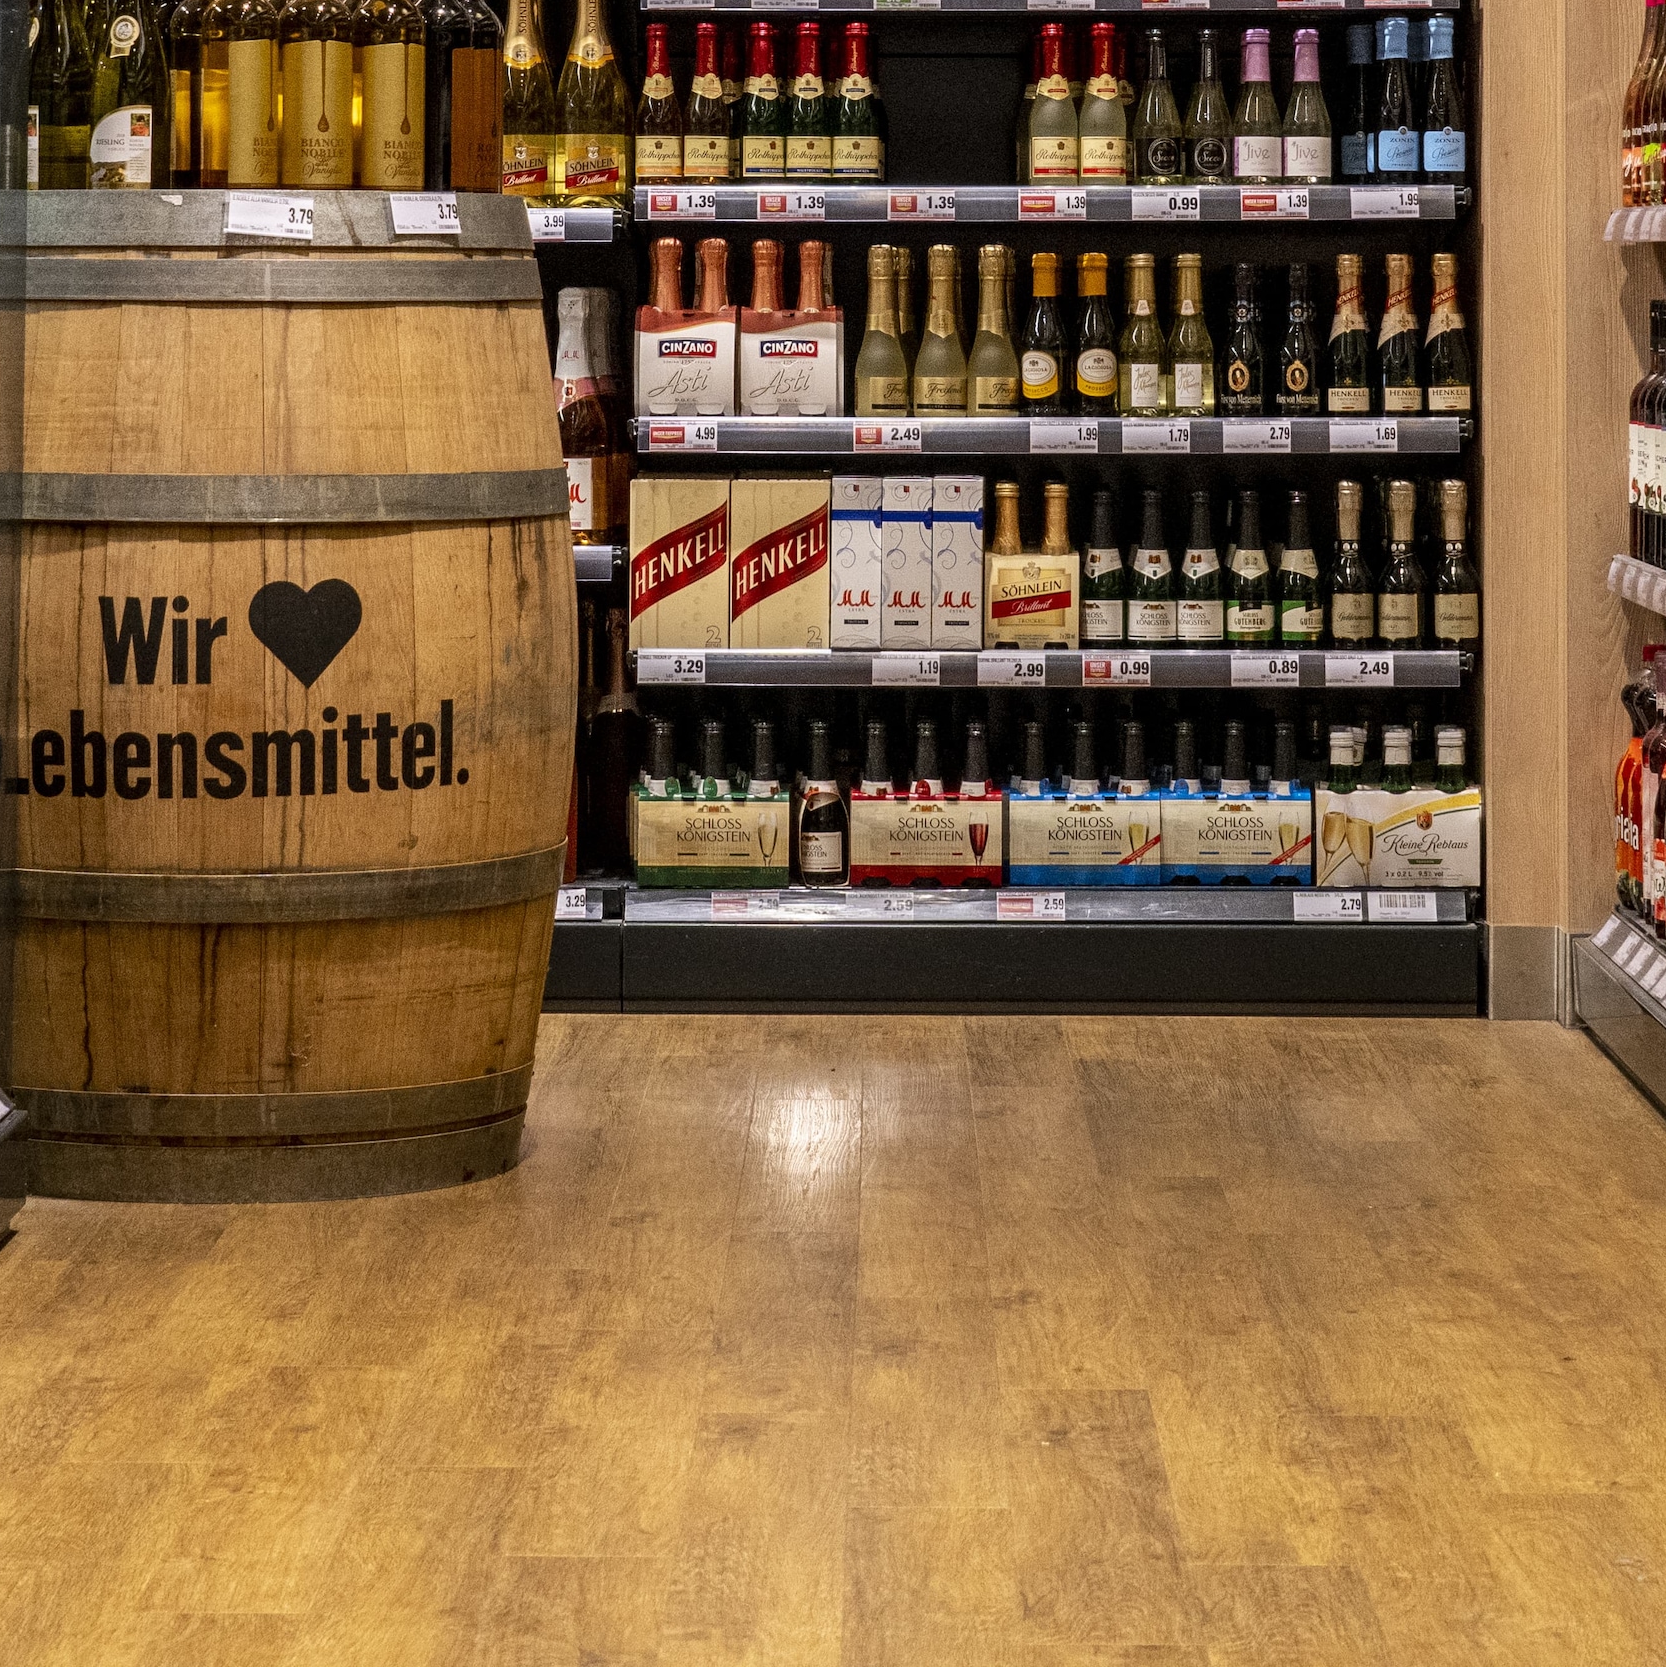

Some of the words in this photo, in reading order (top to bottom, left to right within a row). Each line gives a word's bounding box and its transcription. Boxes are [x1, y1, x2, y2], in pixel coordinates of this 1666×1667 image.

[1390, 136, 1415, 144] ZONIN
[1435, 136, 1460, 144] ZONIN
[569, 154, 615, 174] SÖHNLEIN
[687, 196, 715, 209] 1.39
[796, 196, 824, 209] 1.39
[926, 196, 955, 209] 1.39
[1065, 197, 1086, 210] 1.39
[1168, 198, 1198, 211] 0.99
[1287, 196, 1308, 209] 1.39
[1399, 193, 1419, 206] 1.99
[288, 208, 313, 225] 3.79
[438, 203, 459, 220] 3.79
[544, 214, 564, 228] 3.99
[661, 341, 714, 356] CINZANO
[763, 341, 816, 356] CINZANO
[648, 367, 712, 398] Asti
[749, 367, 815, 398] Asti
[1331, 390, 1366, 398] HENKELL
[695, 428, 715, 440] 4.99
[1077, 428, 1097, 441] 1.99
[1168, 428, 1189, 442] 1.79
[1269, 427, 1290, 441] 2.79
[1376, 427, 1396, 440] 1.69
[634, 522, 725, 600] HENKELL
[735, 522, 826, 600] HENKELL
[1001, 579, 1062, 598] SÖHNLEIN
[1011, 598, 1053, 616] Brillant
[1234, 617, 1267, 626] GUTENBERG
[99, 595, 228, 685] Wir
[706, 625, 723, 642] 2
[807, 625, 823, 642] 2
[674, 660, 703, 675] 3.29
[919, 660, 939, 675] 1.19
[1014, 663, 1044, 678] 2.99
[1120, 661, 1150, 675] 0.99
[1269, 660, 1298, 674] 0.89
[1360, 661, 1389, 675] 2.49
[5, 699, 470, 800] ebensmittel.
[686, 817, 743, 830] SCHLOSS
[899, 817, 955, 830] SCHLOSS
[1056, 816, 1114, 829] SCHLOSS
[1207, 816, 1264, 829] SCHLOSS
[676, 828, 751, 843] KÖNIGSTEIN
[889, 828, 964, 843] KÖNIGSTEIN
[1048, 827, 1123, 843] KÖNIGSTEIN
[1198, 827, 1273, 843] KÖNIGSTEIN
[1382, 833, 1425, 855] Kleine
[1425, 835, 1469, 856] Reblaus
[565, 894, 586, 909] 3.29
[884, 899, 913, 912] 2.59
[1044, 898, 1065, 911] 2.59
[1341, 898, 1362, 912] 2.79
